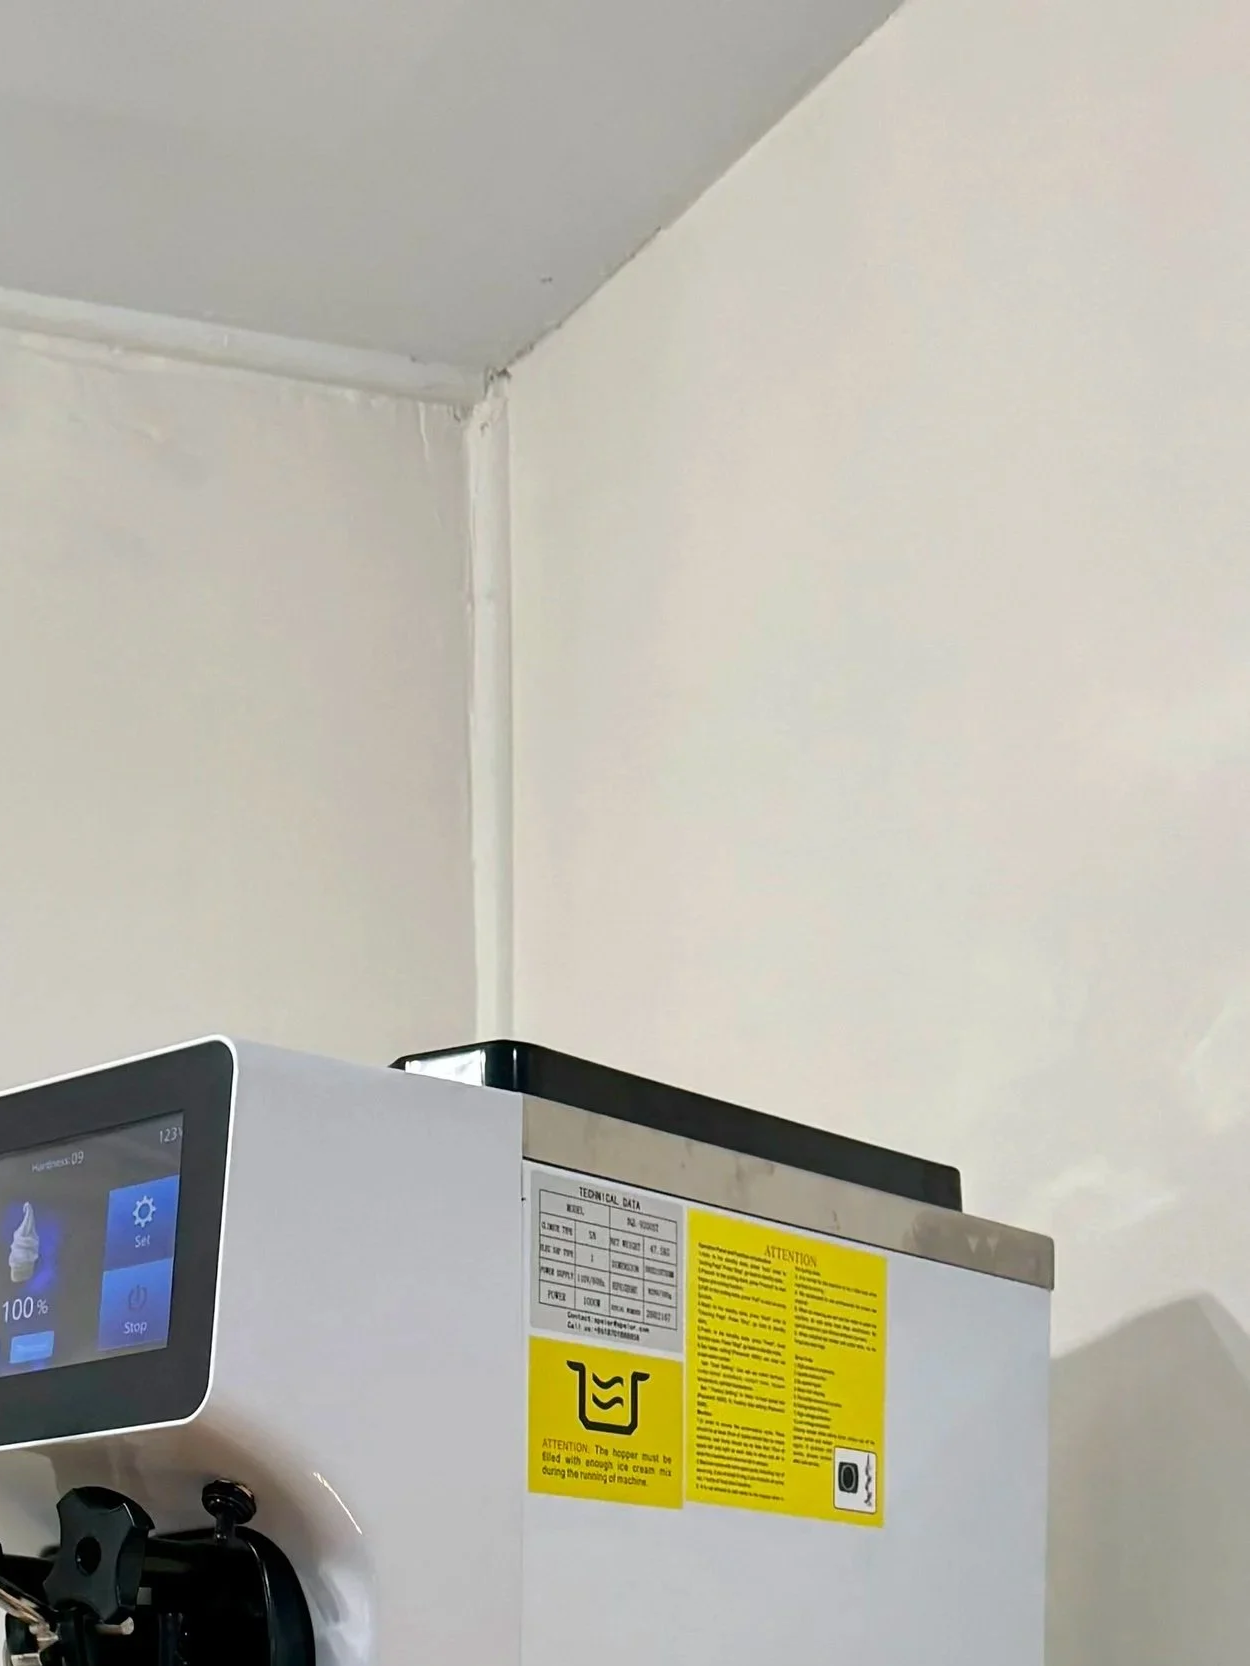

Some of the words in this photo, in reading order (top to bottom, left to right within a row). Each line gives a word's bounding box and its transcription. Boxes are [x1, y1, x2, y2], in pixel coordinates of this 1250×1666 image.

[579, 1186, 619, 1206] TECHNICAL
[622, 1197, 641, 1210] DATA
[134, 1234, 150, 1248] Set
[764, 1244, 818, 1268] ATTENTION
[2, 1296, 34, 1323] 100
[124, 1321, 148, 1335] Stop
[594, 1444, 608, 1456] The
[612, 1448, 638, 1461] hopper
[642, 1452, 659, 1462] must
[662, 1455, 672, 1464] be
[542, 1466, 566, 1479] during
[567, 1468, 578, 1478] the
[580, 1470, 608, 1484] running
[608, 1473, 616, 1483] of
[566, 1456, 581, 1466] with
[586, 1458, 613, 1470] enough
[617, 1462, 628, 1472] ice
[632, 1464, 655, 1474] cream
[660, 1467, 672, 1477] mix
